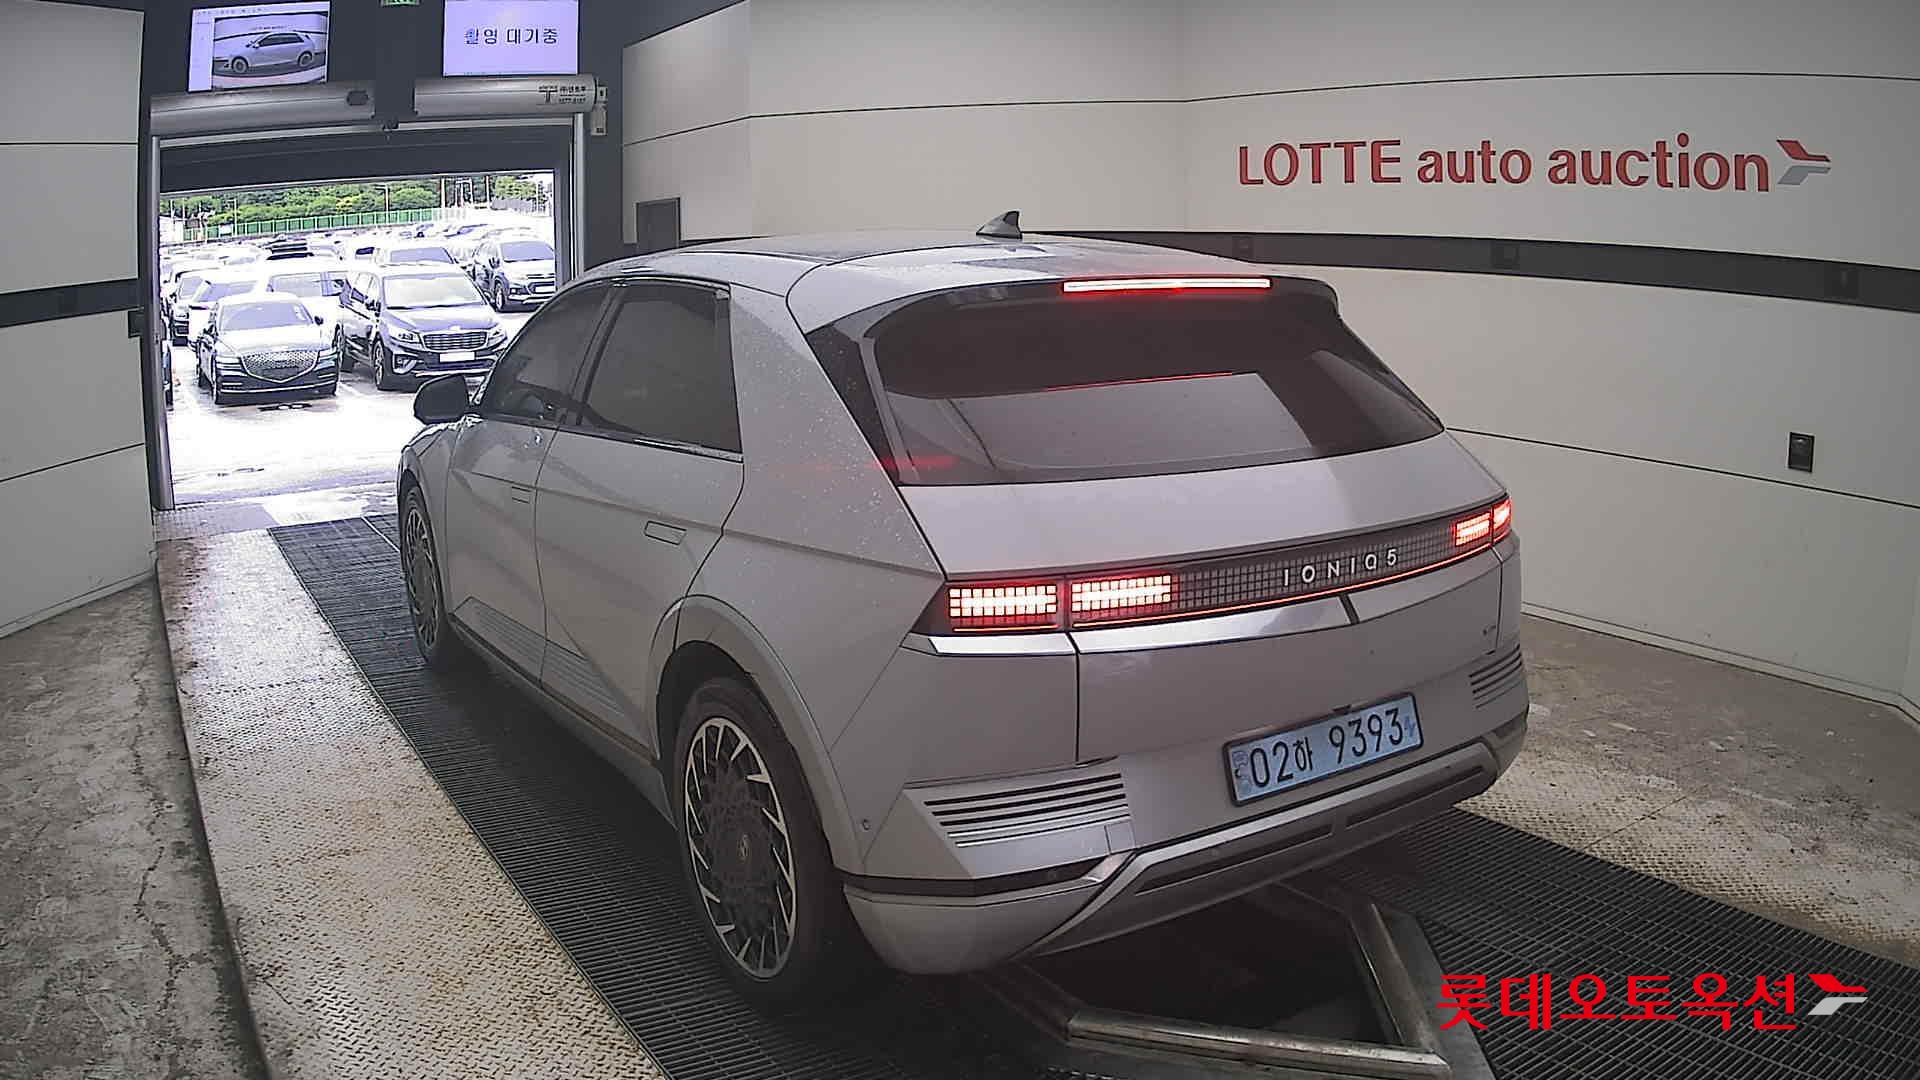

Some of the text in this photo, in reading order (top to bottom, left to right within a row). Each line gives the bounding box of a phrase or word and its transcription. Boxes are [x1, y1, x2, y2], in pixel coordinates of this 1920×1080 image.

[506, 27, 559, 45] 대기중
[1239, 131, 1771, 192] LOTTE auto auction
[1249, 706, 1405, 788] 02하 9393
